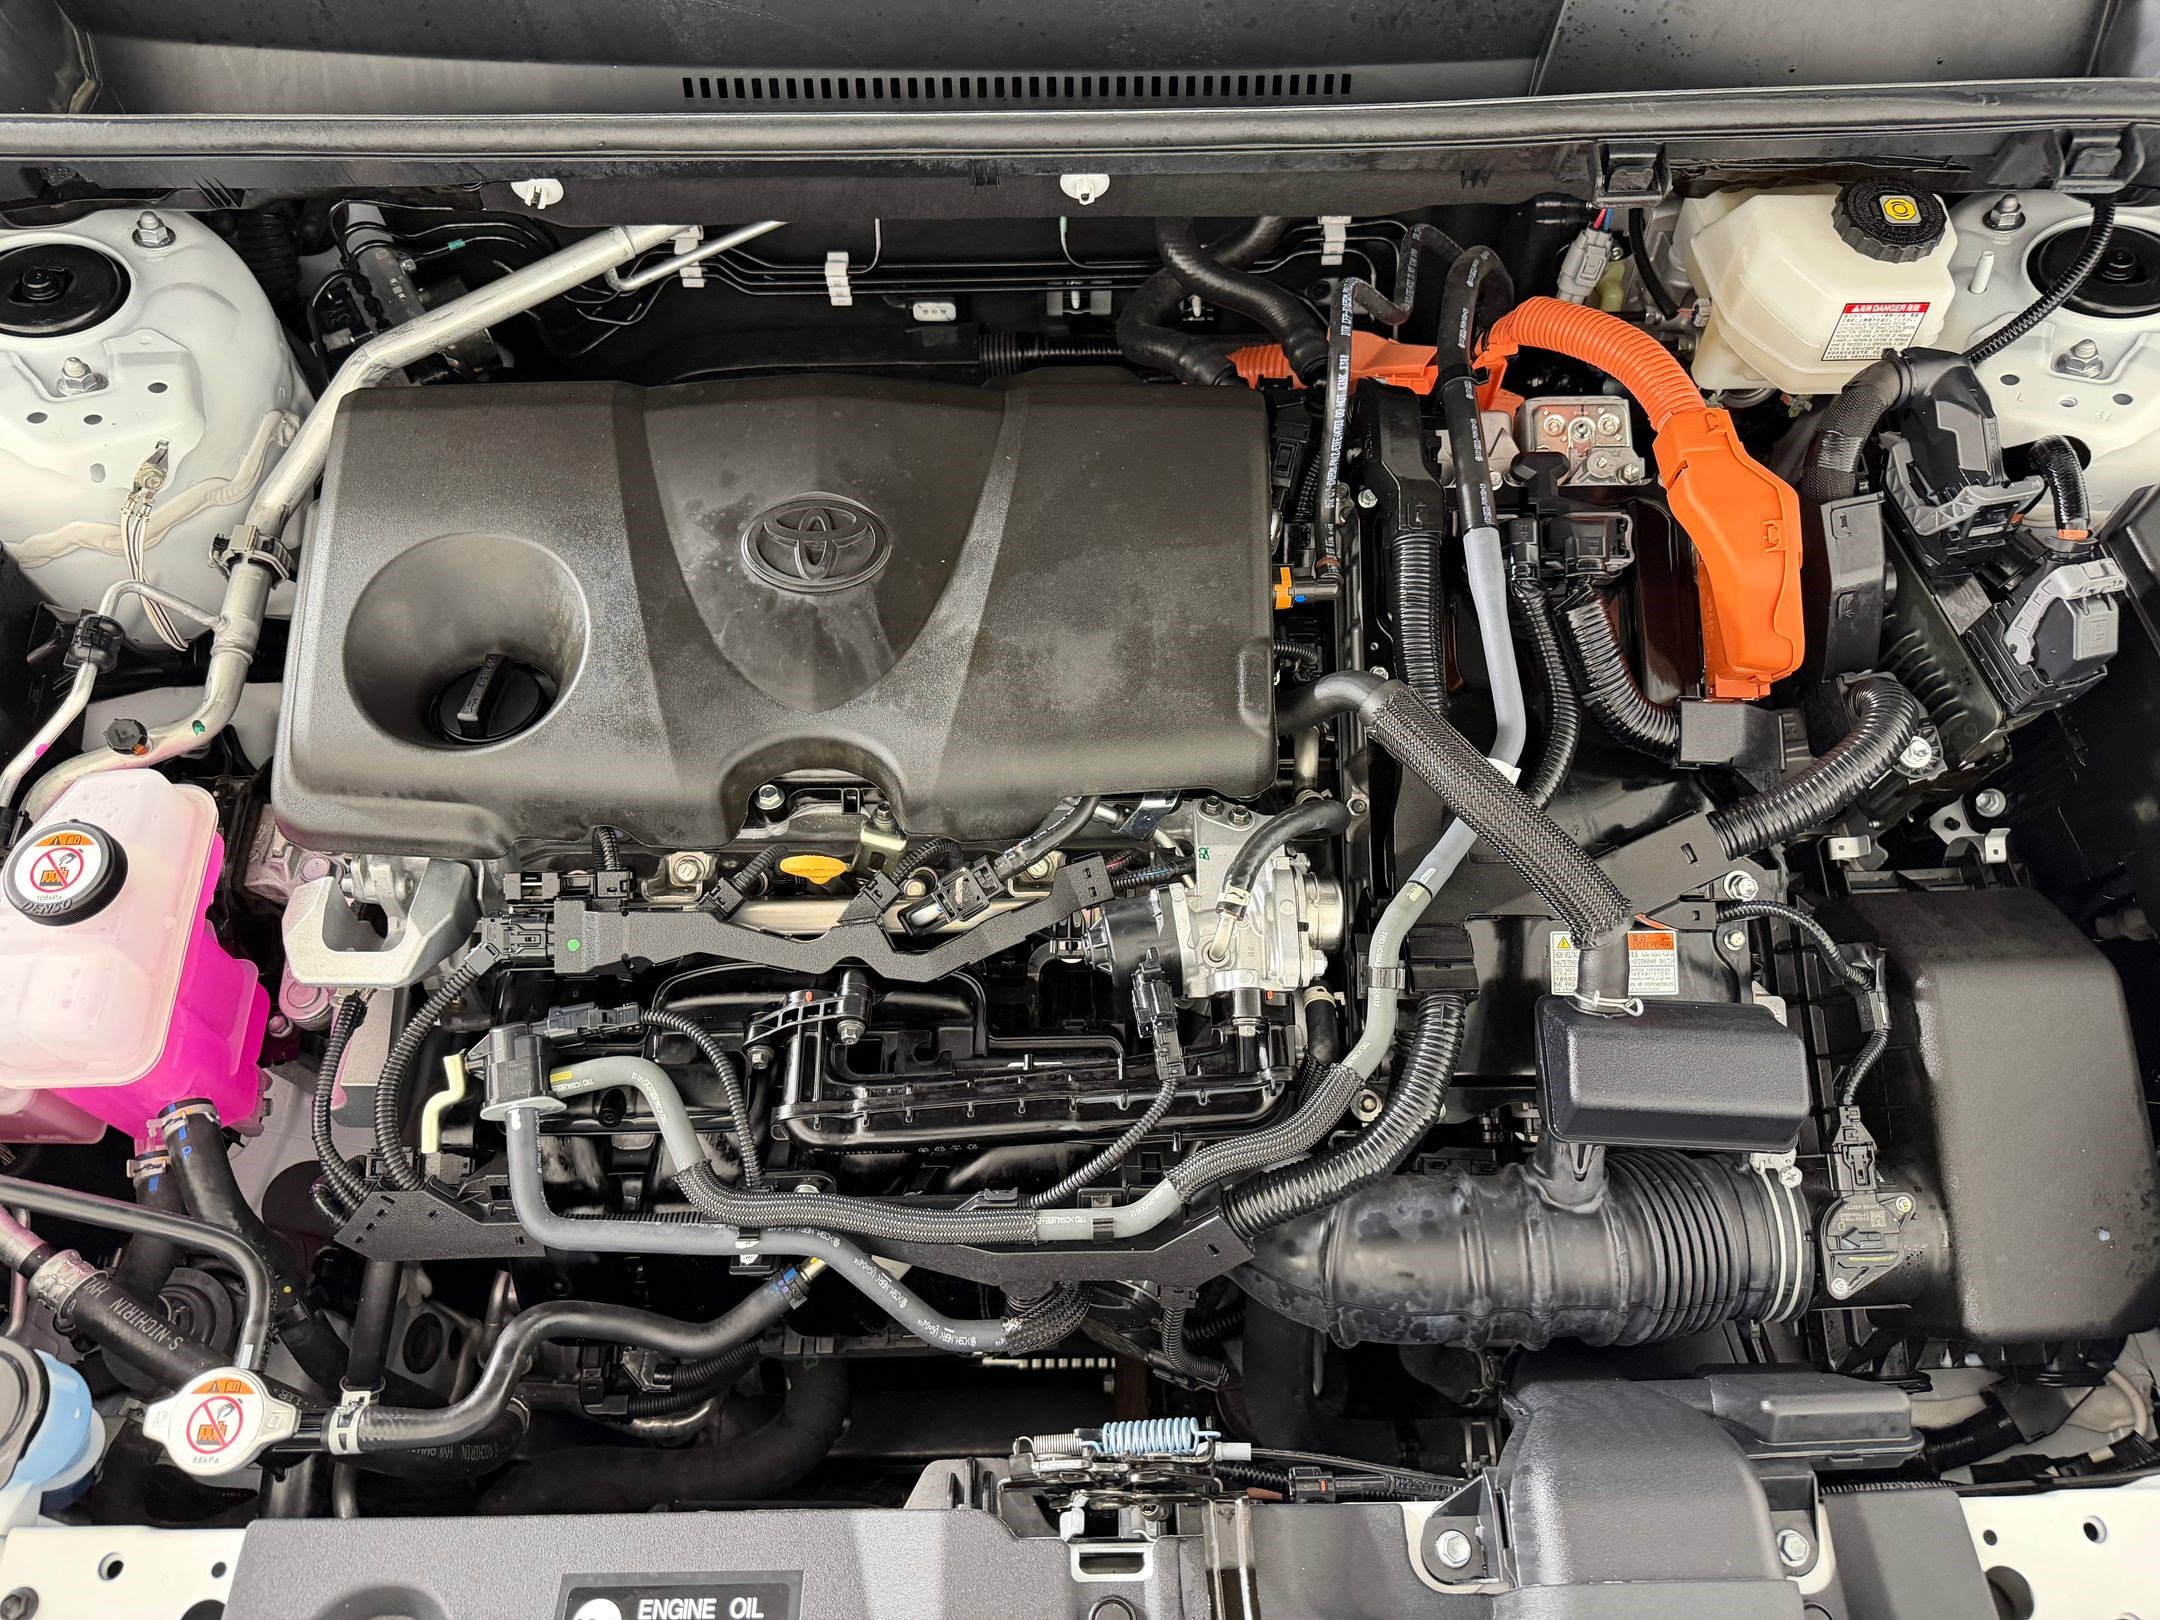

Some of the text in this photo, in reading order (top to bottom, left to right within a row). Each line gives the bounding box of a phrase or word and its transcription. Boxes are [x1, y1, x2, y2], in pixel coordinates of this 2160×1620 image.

[1872, 304, 1906, 312] DANGER
[22, 898, 73, 915] DENSO
[192, 1456, 220, 1464] 88kPa
[637, 1597, 765, 1620] ENGINE OIL
